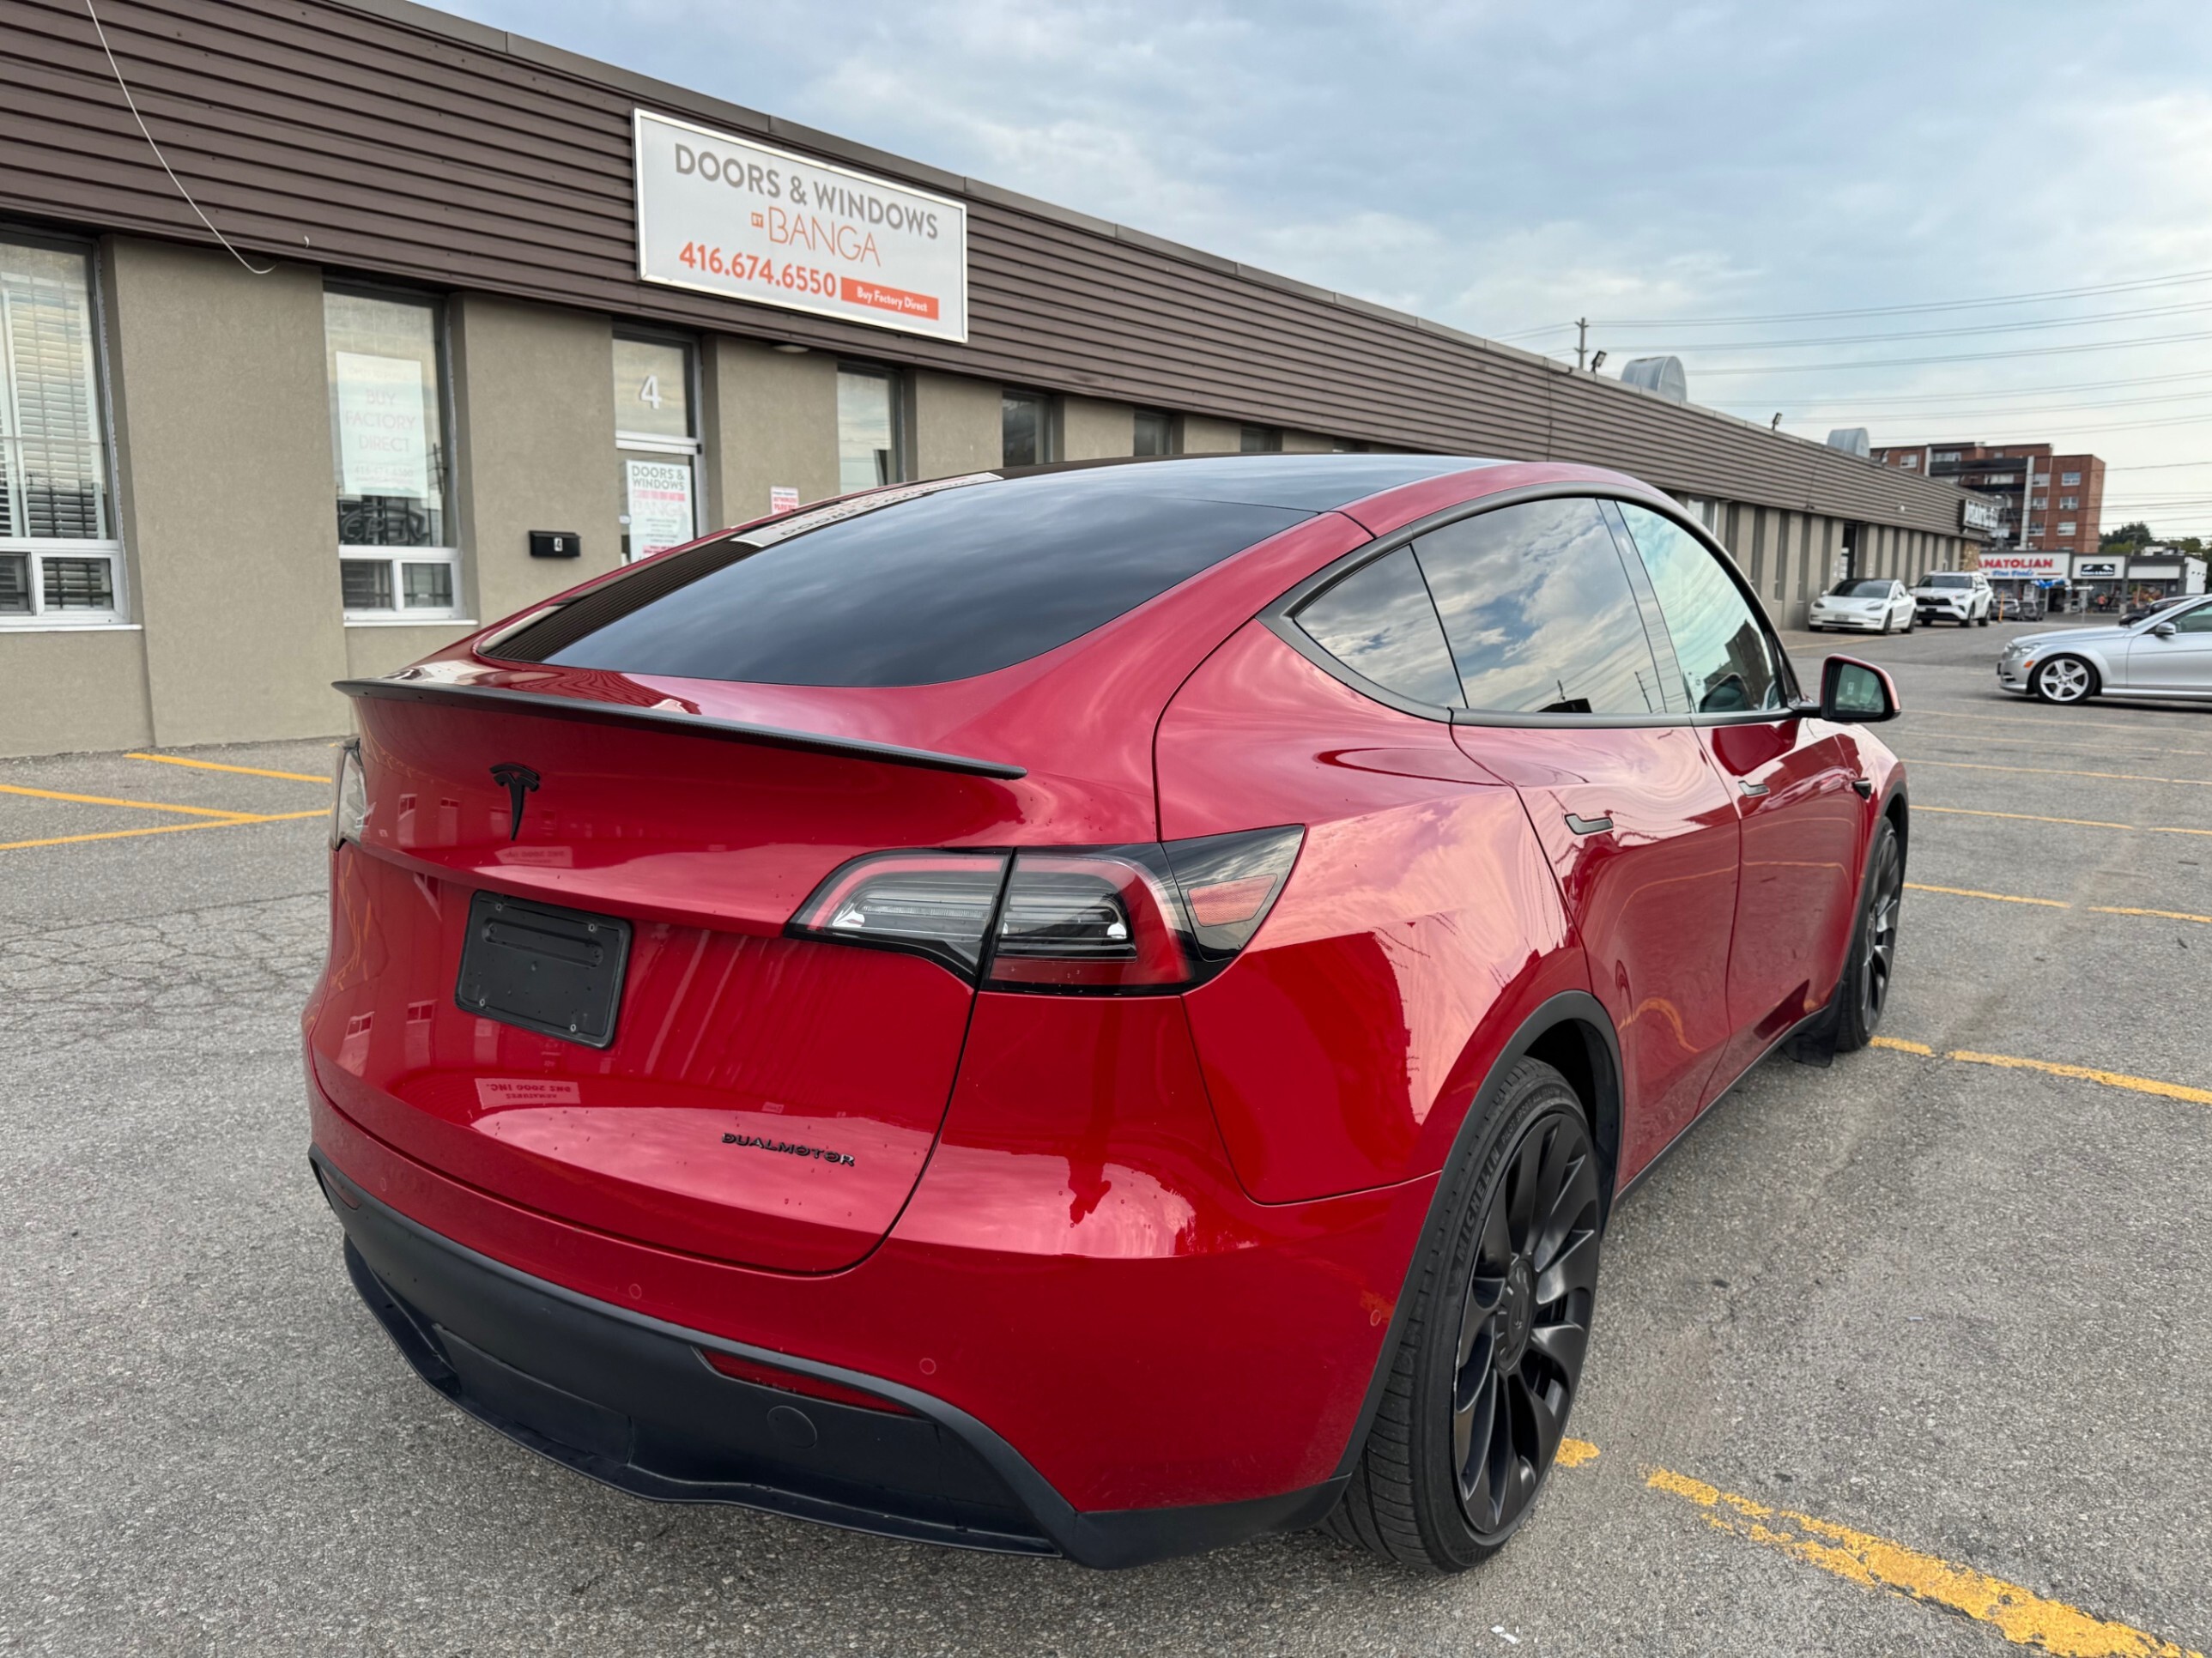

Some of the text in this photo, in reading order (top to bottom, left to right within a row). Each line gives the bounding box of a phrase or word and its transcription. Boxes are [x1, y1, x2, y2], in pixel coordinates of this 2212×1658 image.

[674, 142, 939, 240] DOORS & WINDOWS
[768, 206, 882, 268] BANGA
[678, 241, 836, 298] 416.674.6550
[857, 286, 928, 312] Buy Factory Direct
[366, 389, 397, 405] BUY
[639, 374, 663, 409] 4
[345, 410, 417, 432] FACTORY
[359, 433, 411, 453] DIRECT
[632, 464, 685, 481] DOORS &
[632, 477, 685, 491] WINDOWS
[1457, 1146, 1500, 1263] MICHELIN
[1500, 1118, 1517, 1145] PILOT
[1515, 1099, 1534, 1122] SPORT
